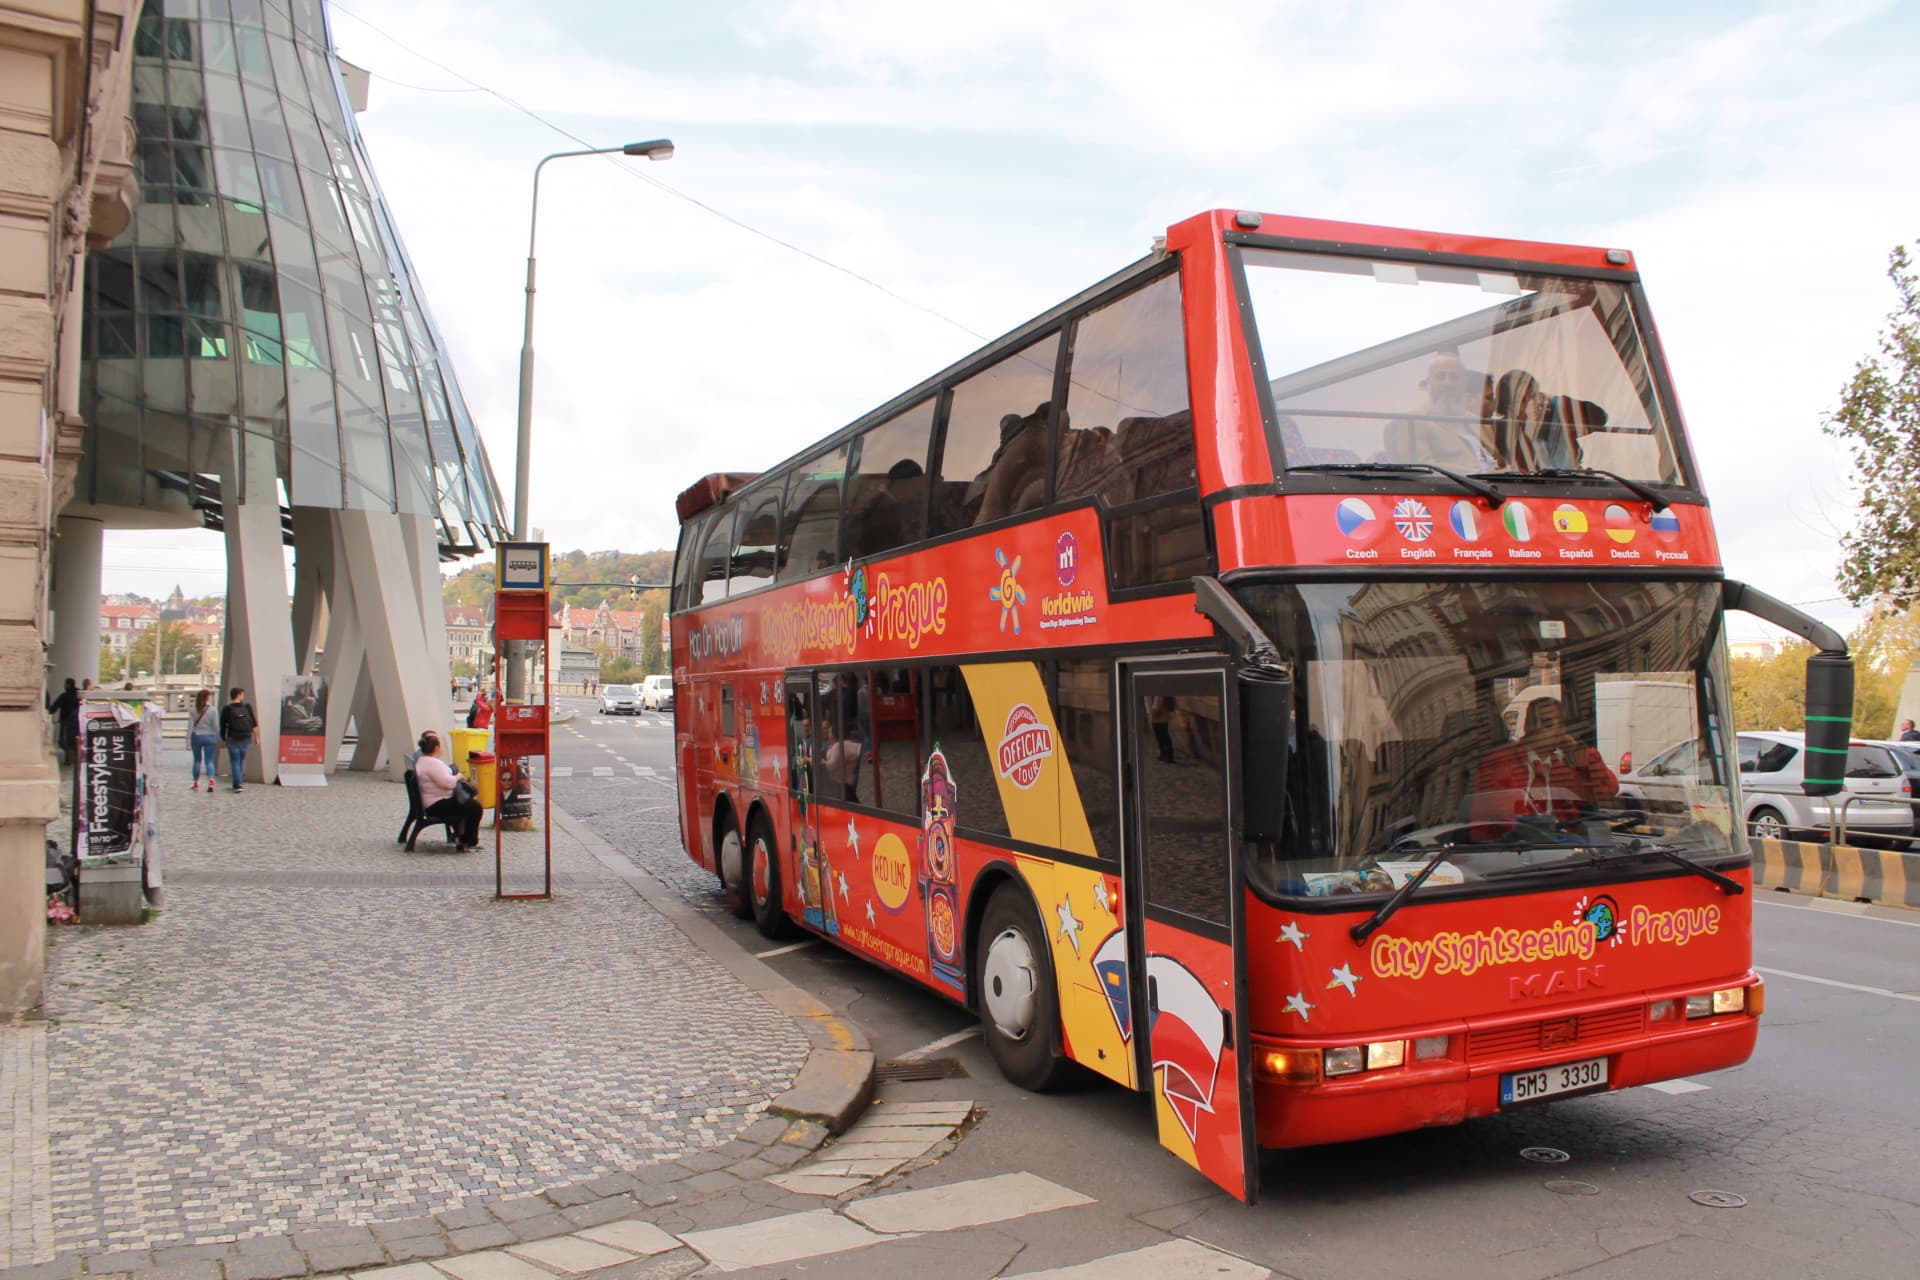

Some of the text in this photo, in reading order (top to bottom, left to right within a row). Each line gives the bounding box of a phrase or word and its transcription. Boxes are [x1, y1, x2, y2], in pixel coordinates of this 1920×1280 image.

[1346, 548, 1378, 559] Czech
[1400, 548, 1436, 560] English
[1453, 548, 1493, 560] Français
[1508, 548, 1542, 558] Italiano
[1559, 548, 1594, 560] Español
[1610, 549, 1640, 559] Deutch
[1655, 550, 1689, 561] Русский
[877, 572, 948, 650] Prague
[1041, 591, 1094, 616] Worldwide
[689, 616, 744, 661] Hop On Hop Off
[112, 735, 125, 761] LIVE
[1003, 730, 1049, 769] OFFICIAL
[1018, 760, 1039, 783] TOUR
[89, 736, 112, 833] Freestylers
[874, 854, 907, 890] RED LINE
[1631, 904, 1720, 946] Prague
[1509, 964, 1605, 1001] MAN
[1516, 1062, 1601, 1097] 5M3 3330
